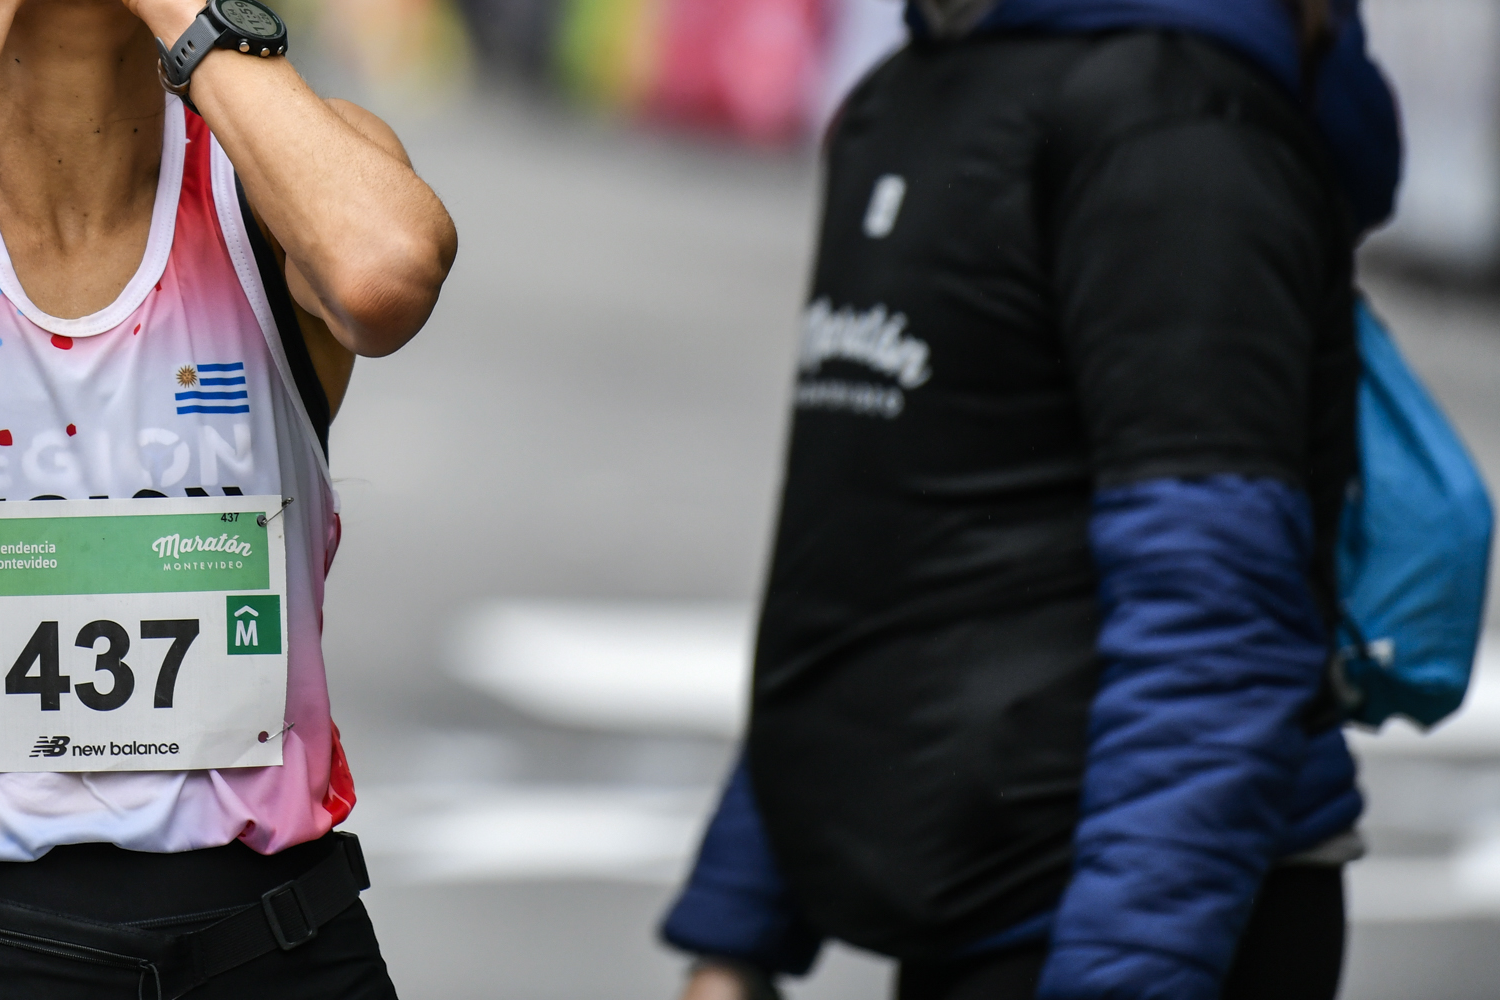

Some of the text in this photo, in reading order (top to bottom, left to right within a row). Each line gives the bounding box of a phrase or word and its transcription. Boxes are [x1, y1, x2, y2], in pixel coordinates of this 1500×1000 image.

[234, 1, 265, 32] 11:59
[220, 512, 240, 523] 437
[151, 533, 253, 559] Maratón
[163, 560, 243, 571] MONTEVIDEO
[5, 618, 200, 712] 437
[72, 744, 106, 757] new
[109, 740, 180, 756] balance
